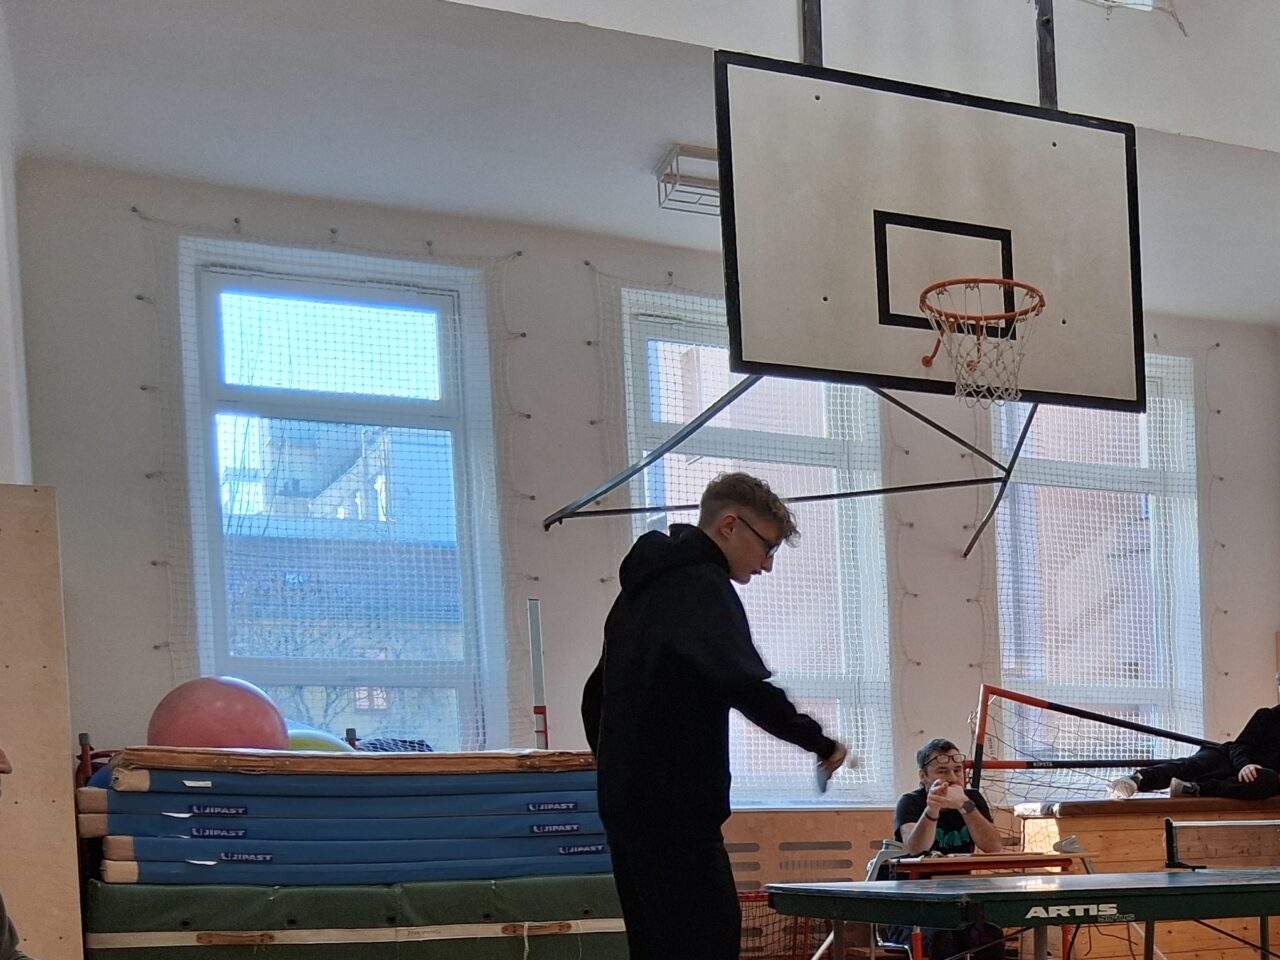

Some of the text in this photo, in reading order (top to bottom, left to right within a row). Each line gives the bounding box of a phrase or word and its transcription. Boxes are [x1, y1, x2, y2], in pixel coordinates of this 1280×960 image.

[543, 824, 580, 832] JIPAST
[567, 845, 604, 853] JIPAST
[233, 853, 273, 861] JIPAST
[1025, 904, 1118, 919] ARTIS
